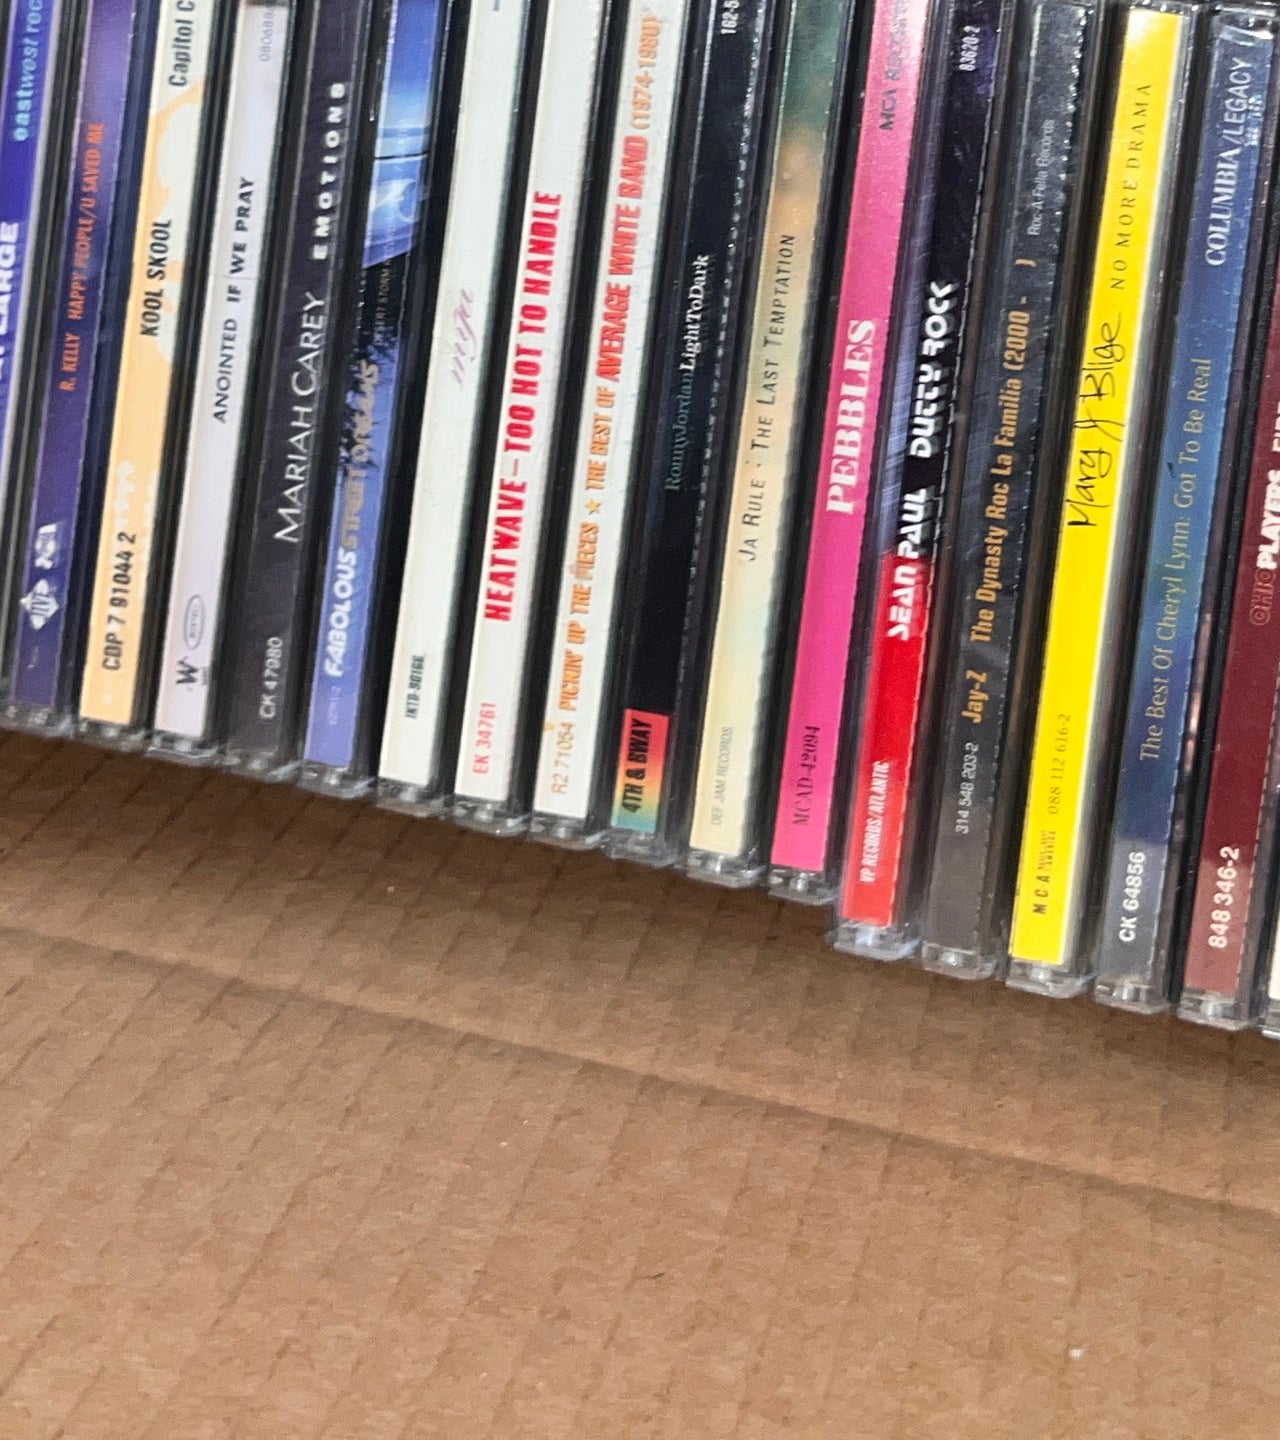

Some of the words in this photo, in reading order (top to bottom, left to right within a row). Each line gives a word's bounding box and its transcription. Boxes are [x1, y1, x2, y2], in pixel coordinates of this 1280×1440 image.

[167, 18, 196, 87] Capitol
[958, 24, 981, 71] 83620-2
[878, 87, 897, 131] MCA
[1035, 117, 1055, 167] Records
[311, 81, 346, 259] EMOTIONS
[617, 135, 648, 199] BAND
[234, 177, 254, 232] PRAY
[1114, 178, 1140, 247] MORE
[146, 219, 171, 280] SKOOL
[229, 241, 246, 274] WE
[139, 288, 163, 336] KOOL
[226, 283, 241, 302] IF
[762, 233, 795, 348] TEMPTATION
[62, 332, 79, 371] KELLY
[291, 289, 326, 396] CAREY
[211, 317, 237, 423] ANOINTED
[757, 358, 779, 405] LAST
[1187, 357, 1212, 402] Real
[749, 415, 772, 451] THE
[826, 318, 876, 514] PEBBLES
[993, 377, 1021, 446] Familia
[1184, 408, 1205, 433] Be
[590, 414, 612, 455] BEST
[1179, 438, 1201, 464] To
[274, 405, 314, 543] MARIAH
[585, 460, 606, 492] THE
[990, 453, 1013, 475] La
[741, 478, 765, 527] RULE
[985, 481, 1010, 519] Roc
[1173, 471, 1197, 508] Got
[974, 525, 1008, 602] Dynasty
[324, 547, 357, 677] FABOLOUS
[570, 584, 592, 615] THE
[1155, 574, 1187, 641] Cheryl
[970, 608, 994, 642] The
[263, 635, 283, 689] 47980
[1151, 643, 1174, 670] Of
[962, 669, 990, 723] Jay-Z
[1144, 675, 1169, 718] Best
[475, 701, 496, 748] 34761
[553, 721, 575, 768] 71054
[1054, 712, 1071, 752] 616-2
[1139, 722, 1163, 761] The
[961, 742, 979, 779] 203-2
[1050, 755, 1066, 780] 112
[620, 782, 644, 813] 4TH
[958, 780, 974, 806] 548
[1046, 785, 1062, 815] 088
[955, 809, 970, 834] 314
[1122, 851, 1146, 911] 64856
[1213, 844, 1240, 906] 346-2
[1118, 915, 1137, 942] CK
[1207, 908, 1231, 948] 848
